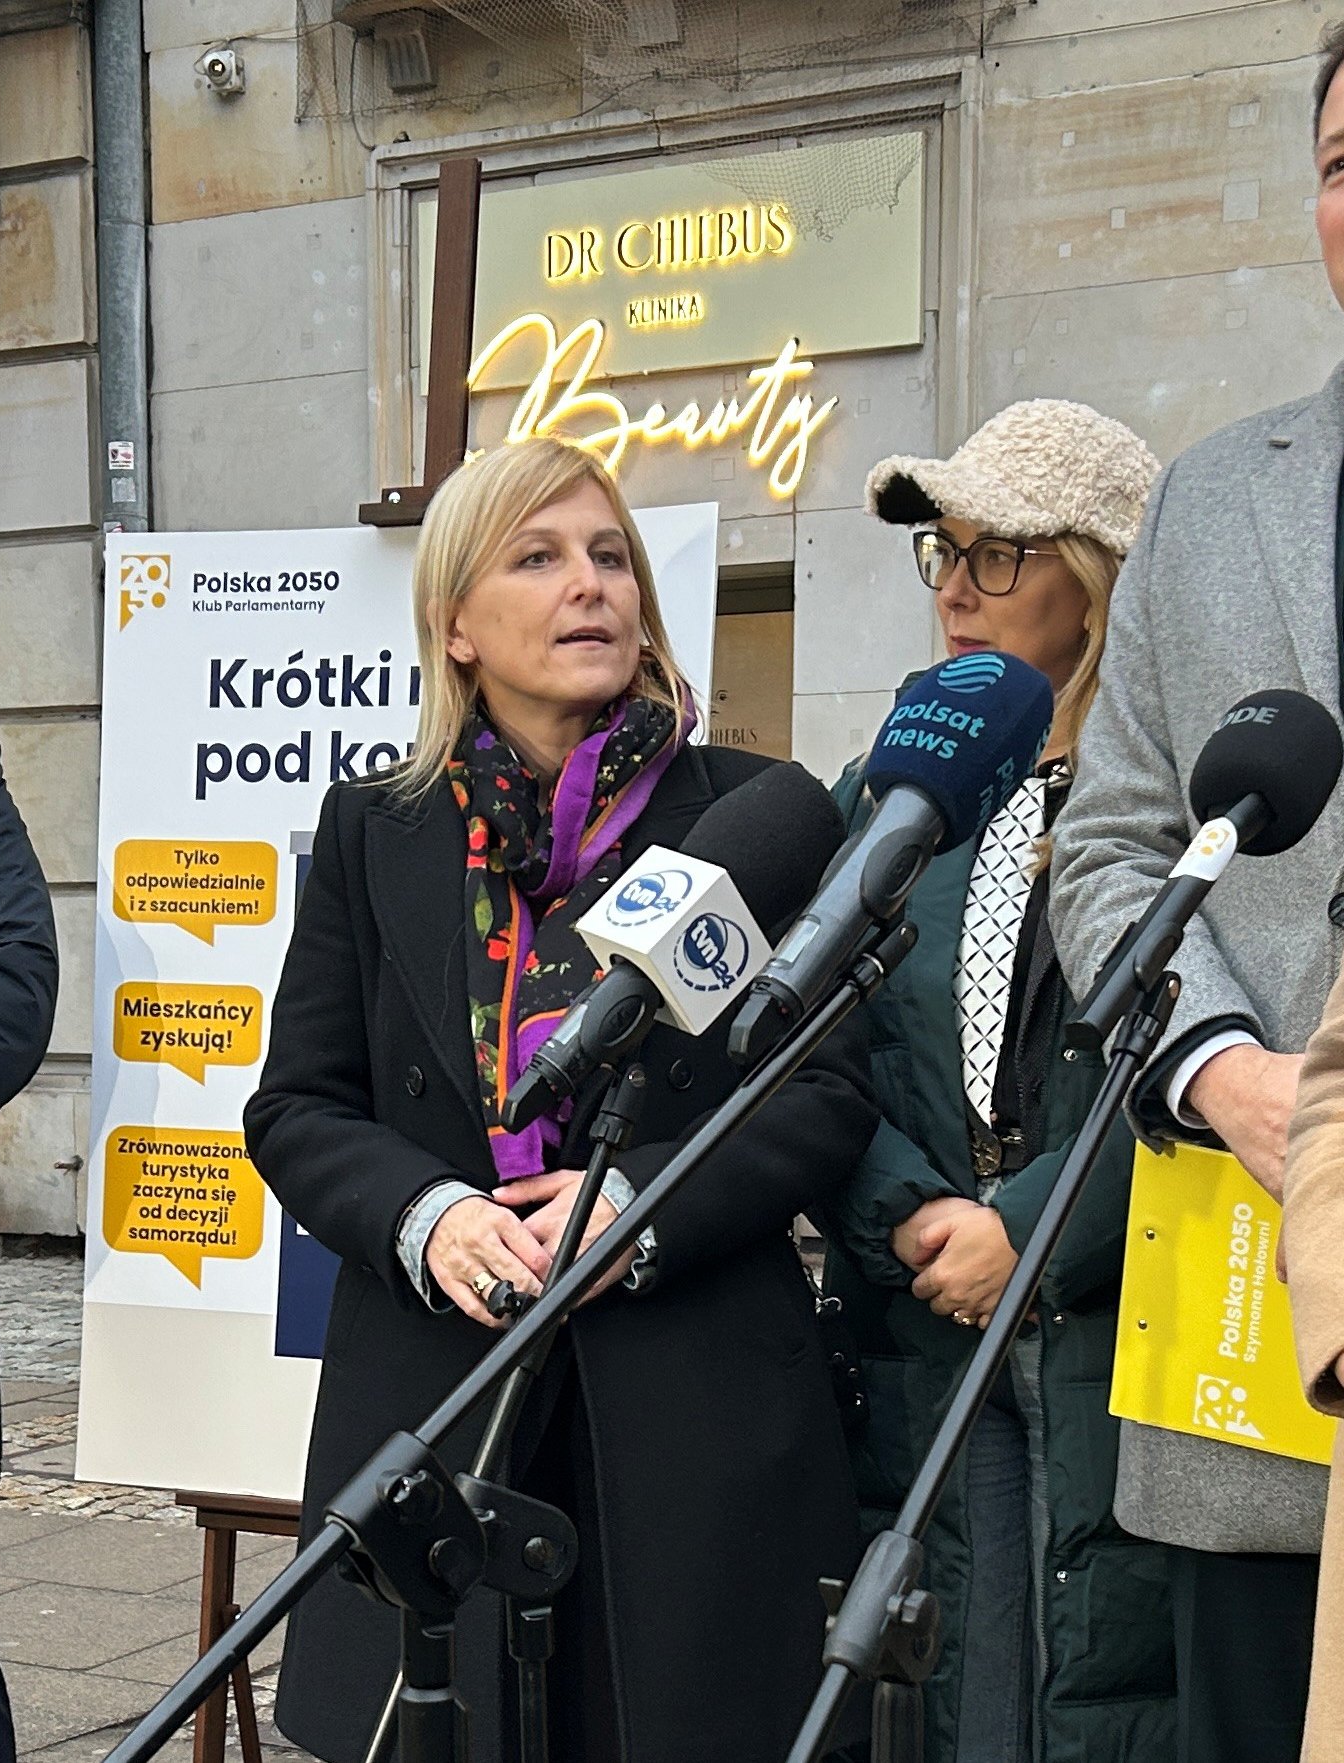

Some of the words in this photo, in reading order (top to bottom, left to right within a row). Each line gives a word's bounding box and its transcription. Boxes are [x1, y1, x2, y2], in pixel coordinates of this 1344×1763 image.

[546, 230, 605, 279] DR
[617, 204, 789, 271] CHLEBUS
[628, 295, 700, 325] KLINIKA
[467, 313, 839, 496] Beauty
[192, 571, 272, 594] Polska
[277, 570, 341, 592] 2050
[192, 599, 223, 612] Klub
[225, 598, 326, 614] Parlamentarny
[209, 649, 393, 709] Krótki
[887, 699, 986, 739] polsat
[882, 727, 959, 760] news
[195, 730, 312, 801] pod
[174, 849, 220, 870] Tylko
[125, 872, 266, 893] odpowiedzialnie
[129, 895, 136, 912] i
[137, 900, 146, 912] z
[150, 897, 260, 916] szacunkiem!
[123, 996, 254, 1027] Mieszkańcy
[140, 1027, 233, 1054] zyskują!
[142, 1160, 230, 1184] turystyka
[132, 1184, 207, 1203] zaczyna
[211, 1184, 237, 1206] się
[139, 1204, 162, 1220] od
[165, 1204, 230, 1228] decyzji
[128, 1226, 238, 1248] samorządu!
[1228, 1201, 1254, 1271] 2050
[1218, 1273, 1246, 1360] Polska
[1243, 1290, 1264, 1364] Szymona
